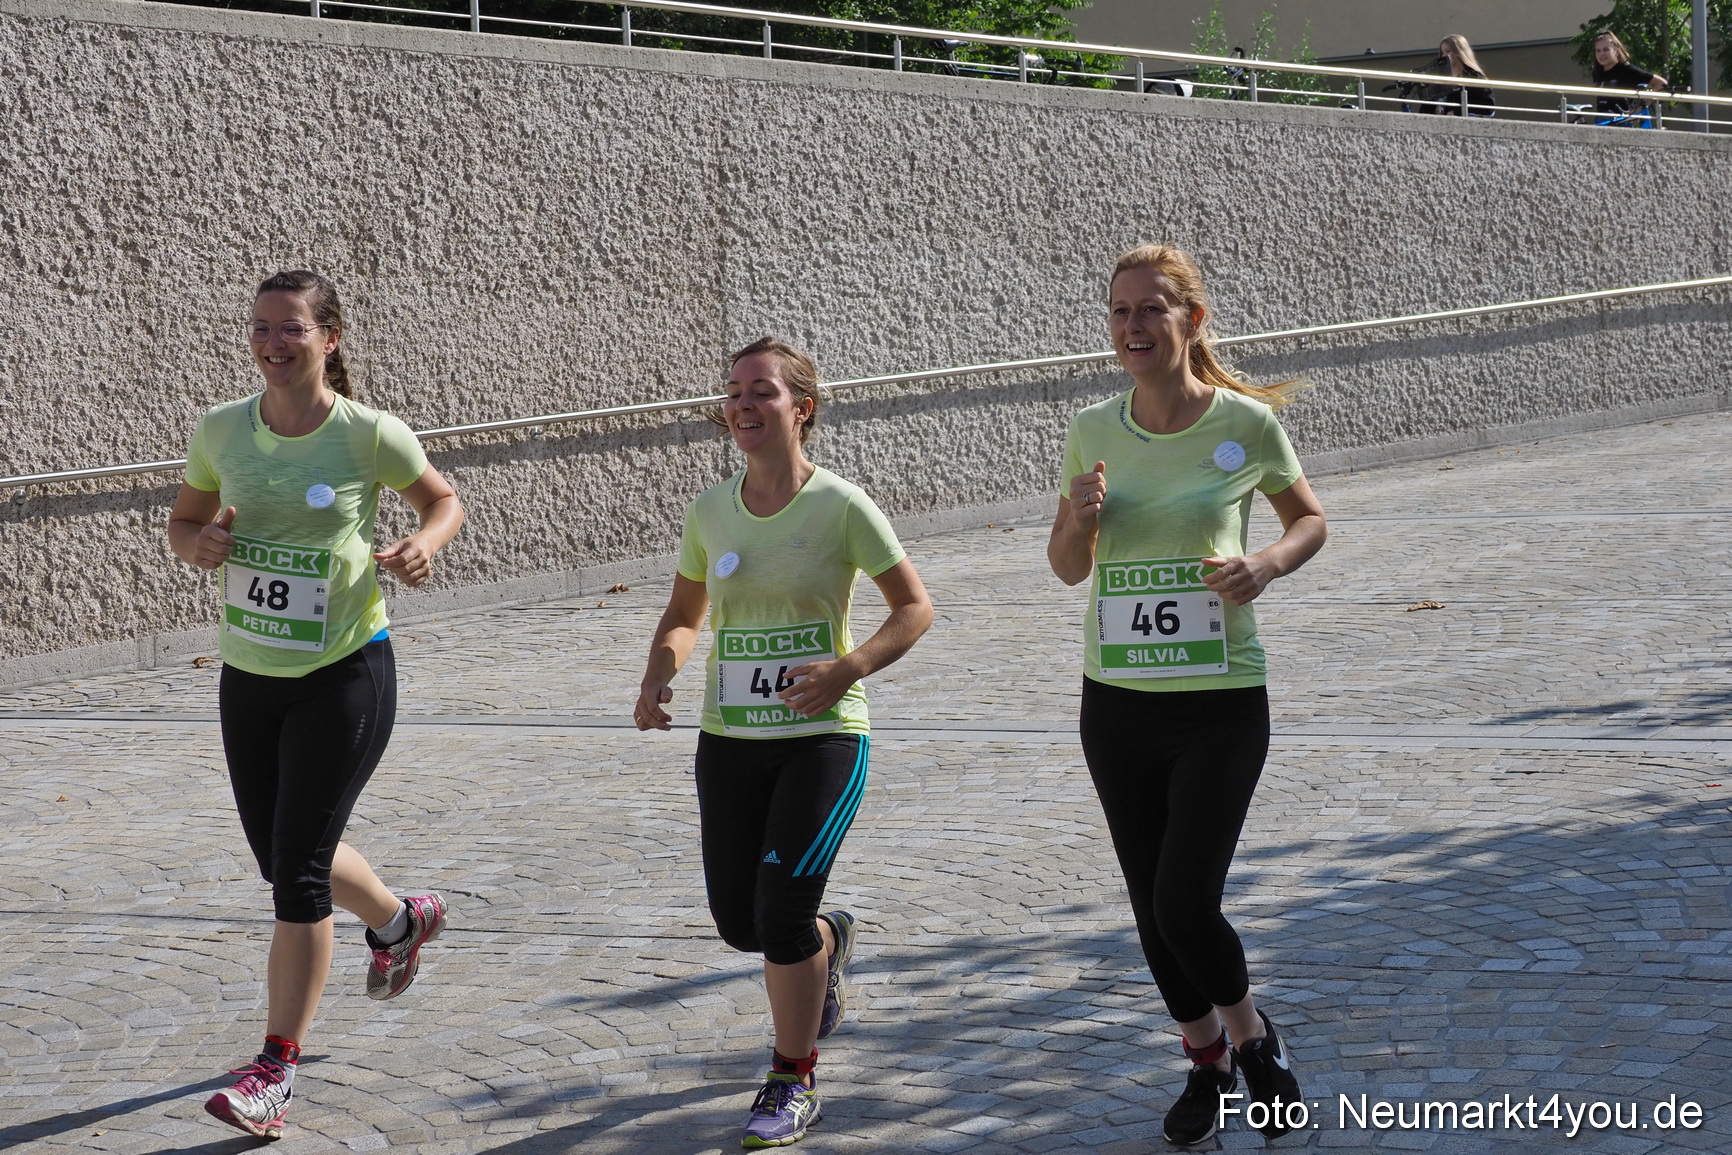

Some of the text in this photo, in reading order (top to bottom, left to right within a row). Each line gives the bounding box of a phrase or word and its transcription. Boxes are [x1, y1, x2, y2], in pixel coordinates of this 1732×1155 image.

[229, 540, 321, 574] BOCK
[1106, 562, 1206, 592] BOCK
[247, 576, 290, 611] 48
[243, 614, 292, 636] PETRA
[1131, 601, 1180, 636] 46
[724, 627, 824, 657] BOCK
[1126, 647, 1190, 664] SILVIA
[750, 666, 796, 698] 44
[746, 709, 809, 724] NADJA
